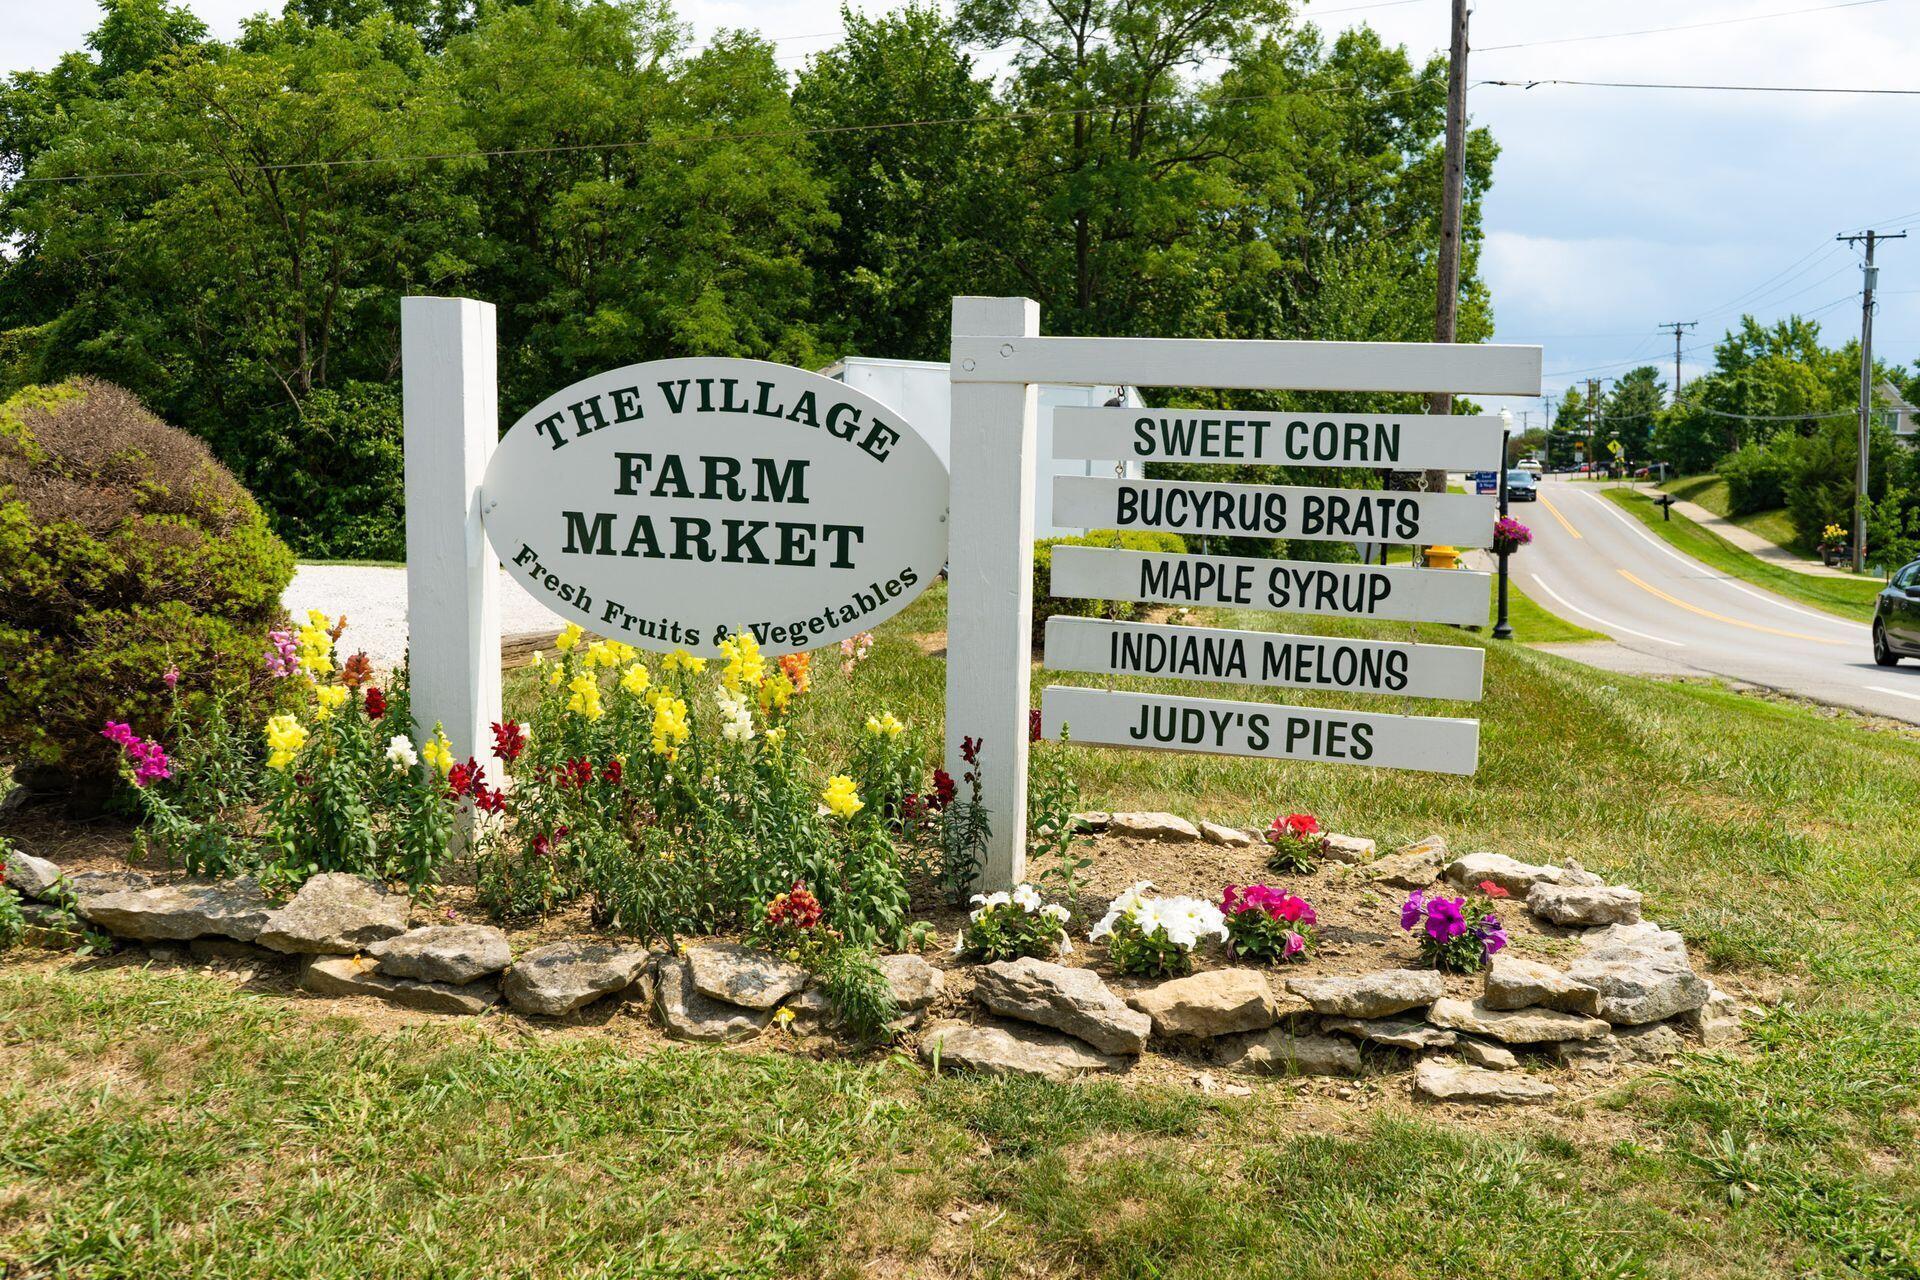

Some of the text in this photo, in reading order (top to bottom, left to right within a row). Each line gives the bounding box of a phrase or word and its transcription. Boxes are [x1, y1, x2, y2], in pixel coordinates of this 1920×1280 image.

[534, 378, 901, 464] THE VILLAGE
[1133, 417, 1401, 462] SWEET CORN
[613, 451, 811, 504] FARM
[561, 510, 864, 570] MARKET
[1116, 486, 1420, 540] BUCYRUS BRATS
[512, 543, 592, 614] Fresh
[600, 599, 700, 646] Fruits
[747, 566, 918, 647] Vegetables
[1140, 558, 1392, 614] MAPLE SYRUP
[1110, 631, 1408, 691] INDIANA MELONS
[1129, 704, 1374, 761] JUDY'S PIES
